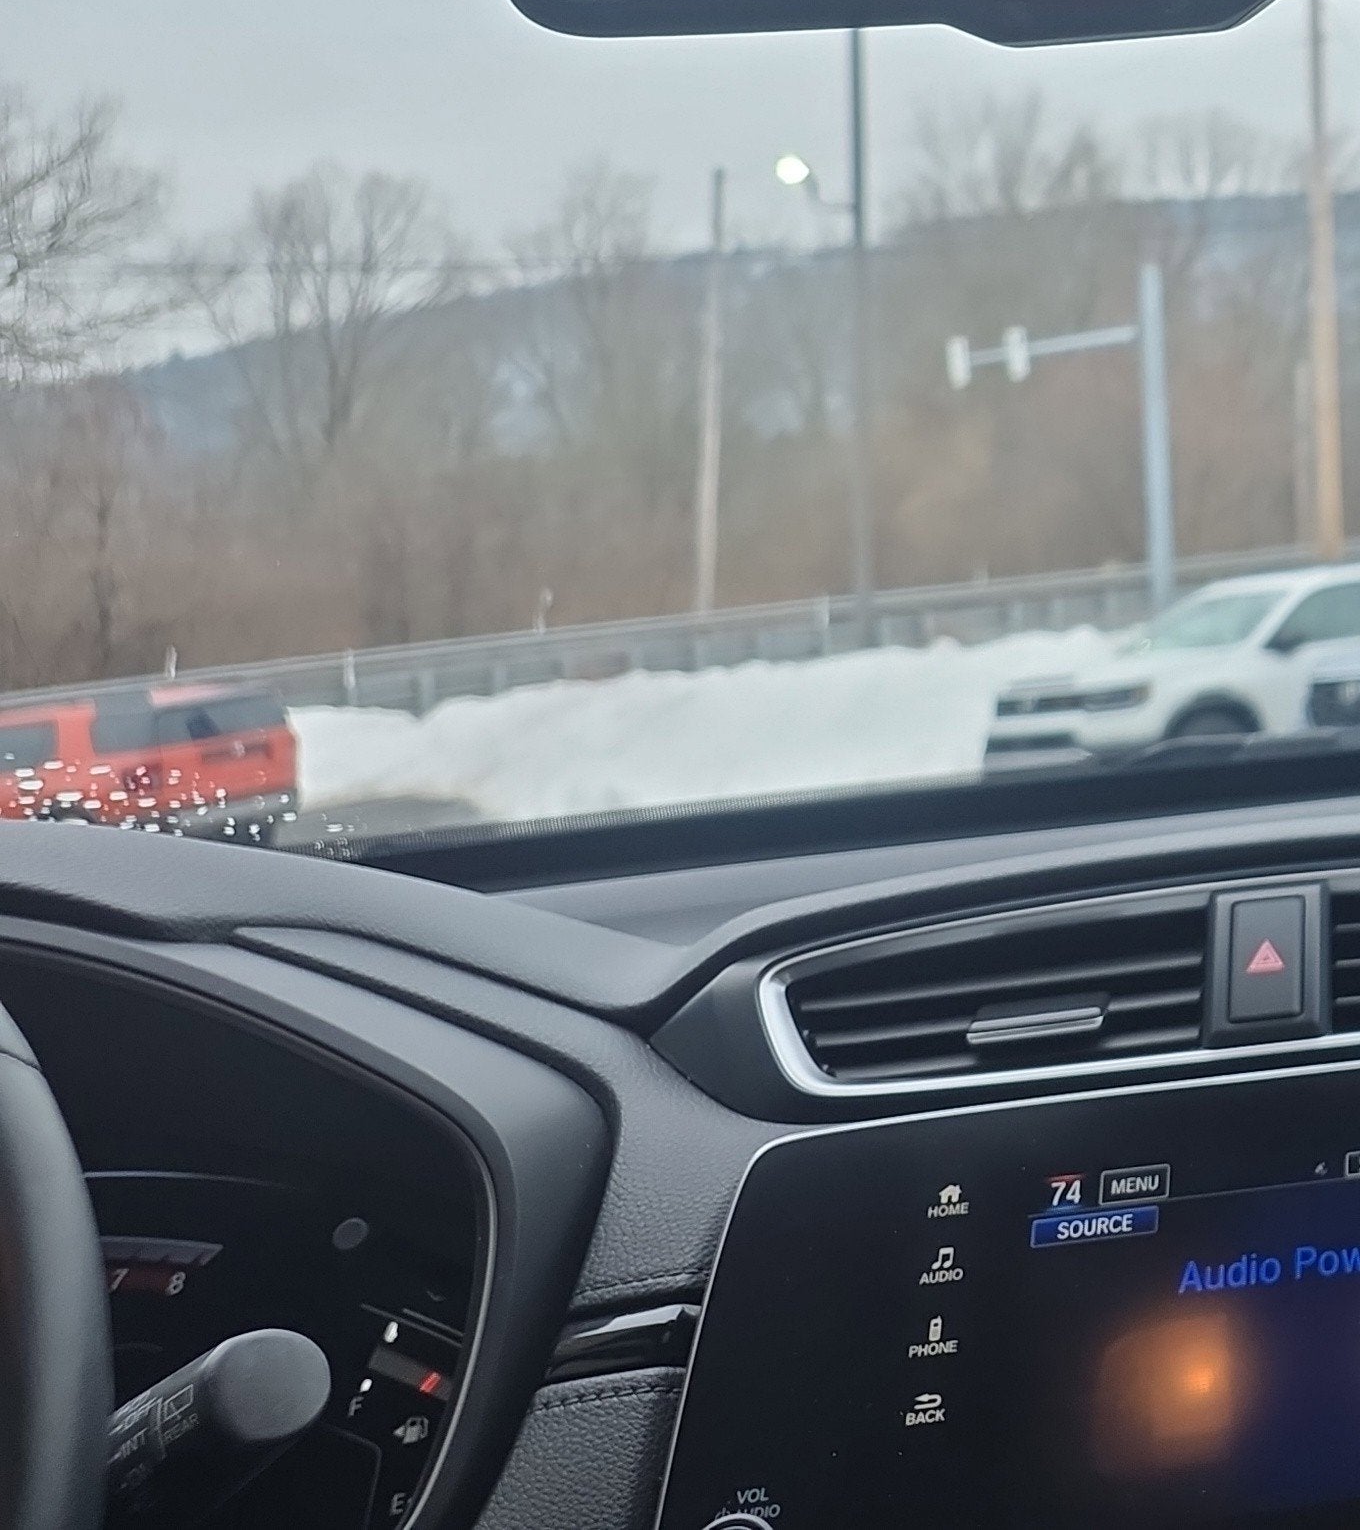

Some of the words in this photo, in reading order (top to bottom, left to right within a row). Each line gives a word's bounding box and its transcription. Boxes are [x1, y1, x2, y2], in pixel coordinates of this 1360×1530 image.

[1051, 1179, 1082, 1206] 74
[1110, 1174, 1159, 1195] MENU
[927, 1201, 970, 1218] HOME
[1056, 1213, 1133, 1240] SOURCE
[166, 1271, 187, 1296] 8
[918, 1268, 964, 1285] AUDIO
[1178, 1252, 1281, 1294] Audio
[908, 1340, 959, 1358] PHONE
[348, 1396, 364, 1417] F
[905, 1409, 946, 1426] BACK
[390, 1492, 405, 1516] E
[737, 1488, 769, 1505] VOL
[737, 1504, 781, 1518] DIO
